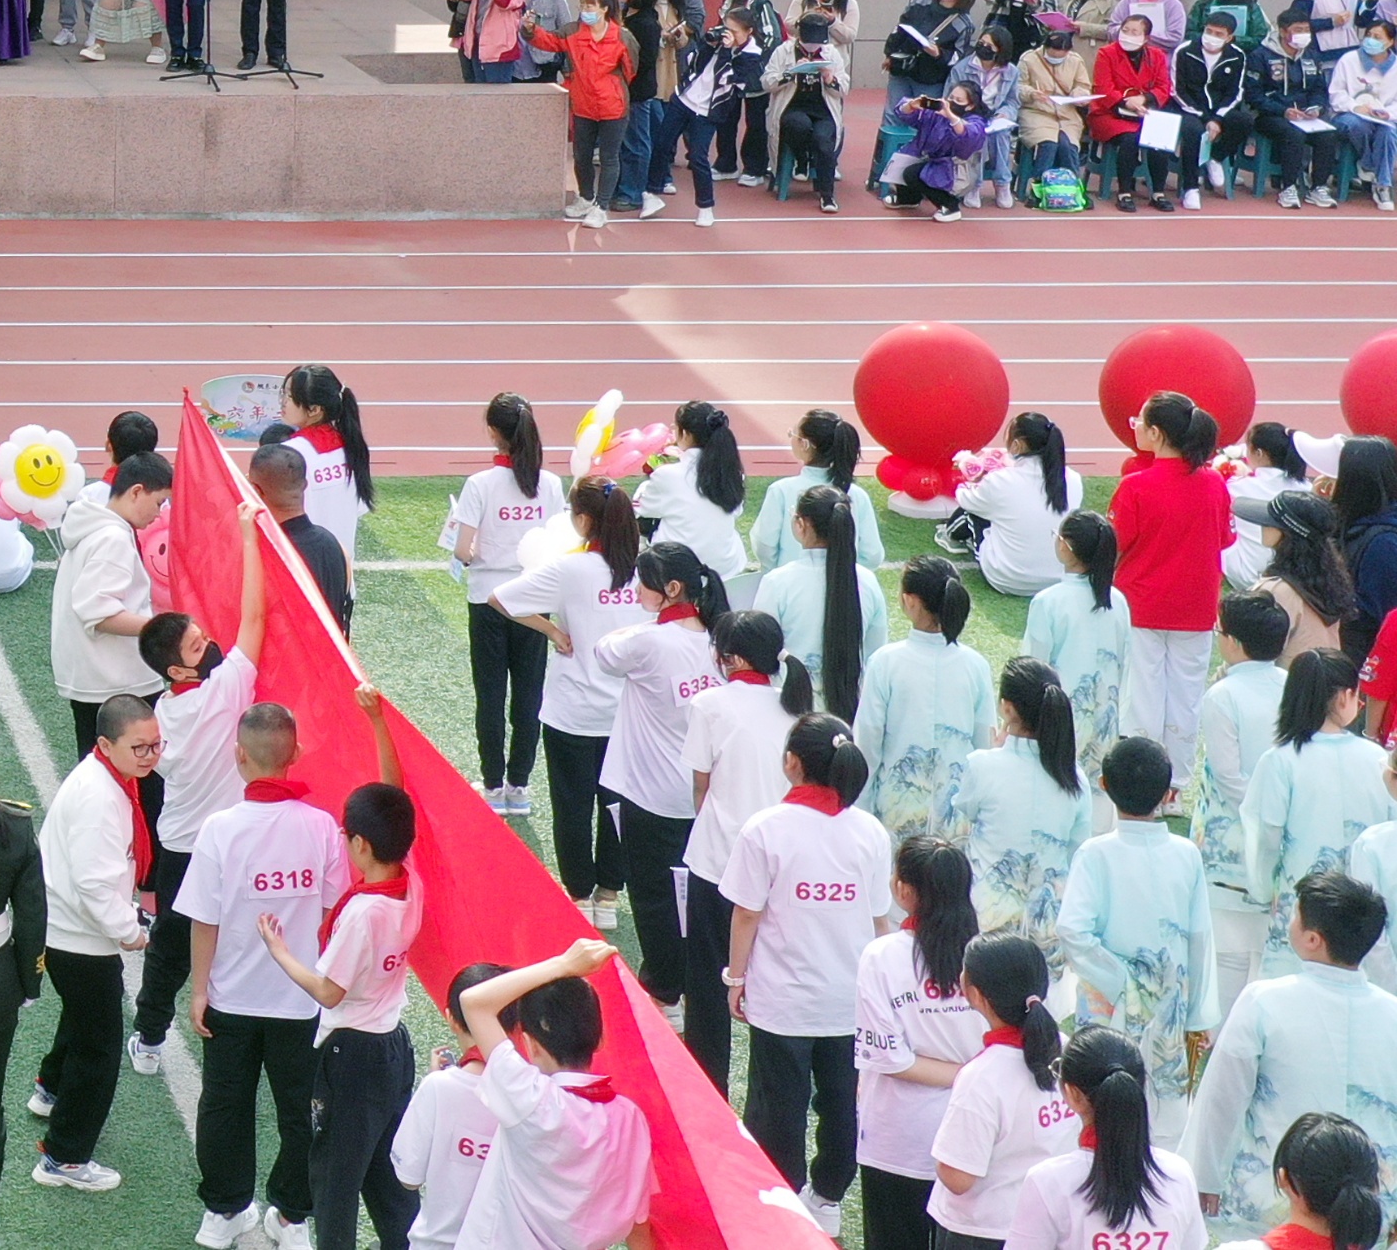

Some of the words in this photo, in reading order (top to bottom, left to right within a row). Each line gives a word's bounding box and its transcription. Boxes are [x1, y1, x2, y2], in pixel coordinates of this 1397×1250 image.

[499, 505, 544, 521] 6321
[254, 868, 314, 892] 6318
[795, 881, 857, 902] 6325
[865, 1028, 898, 1051] BLUE
[1091, 1231, 1170, 1250] 6327
